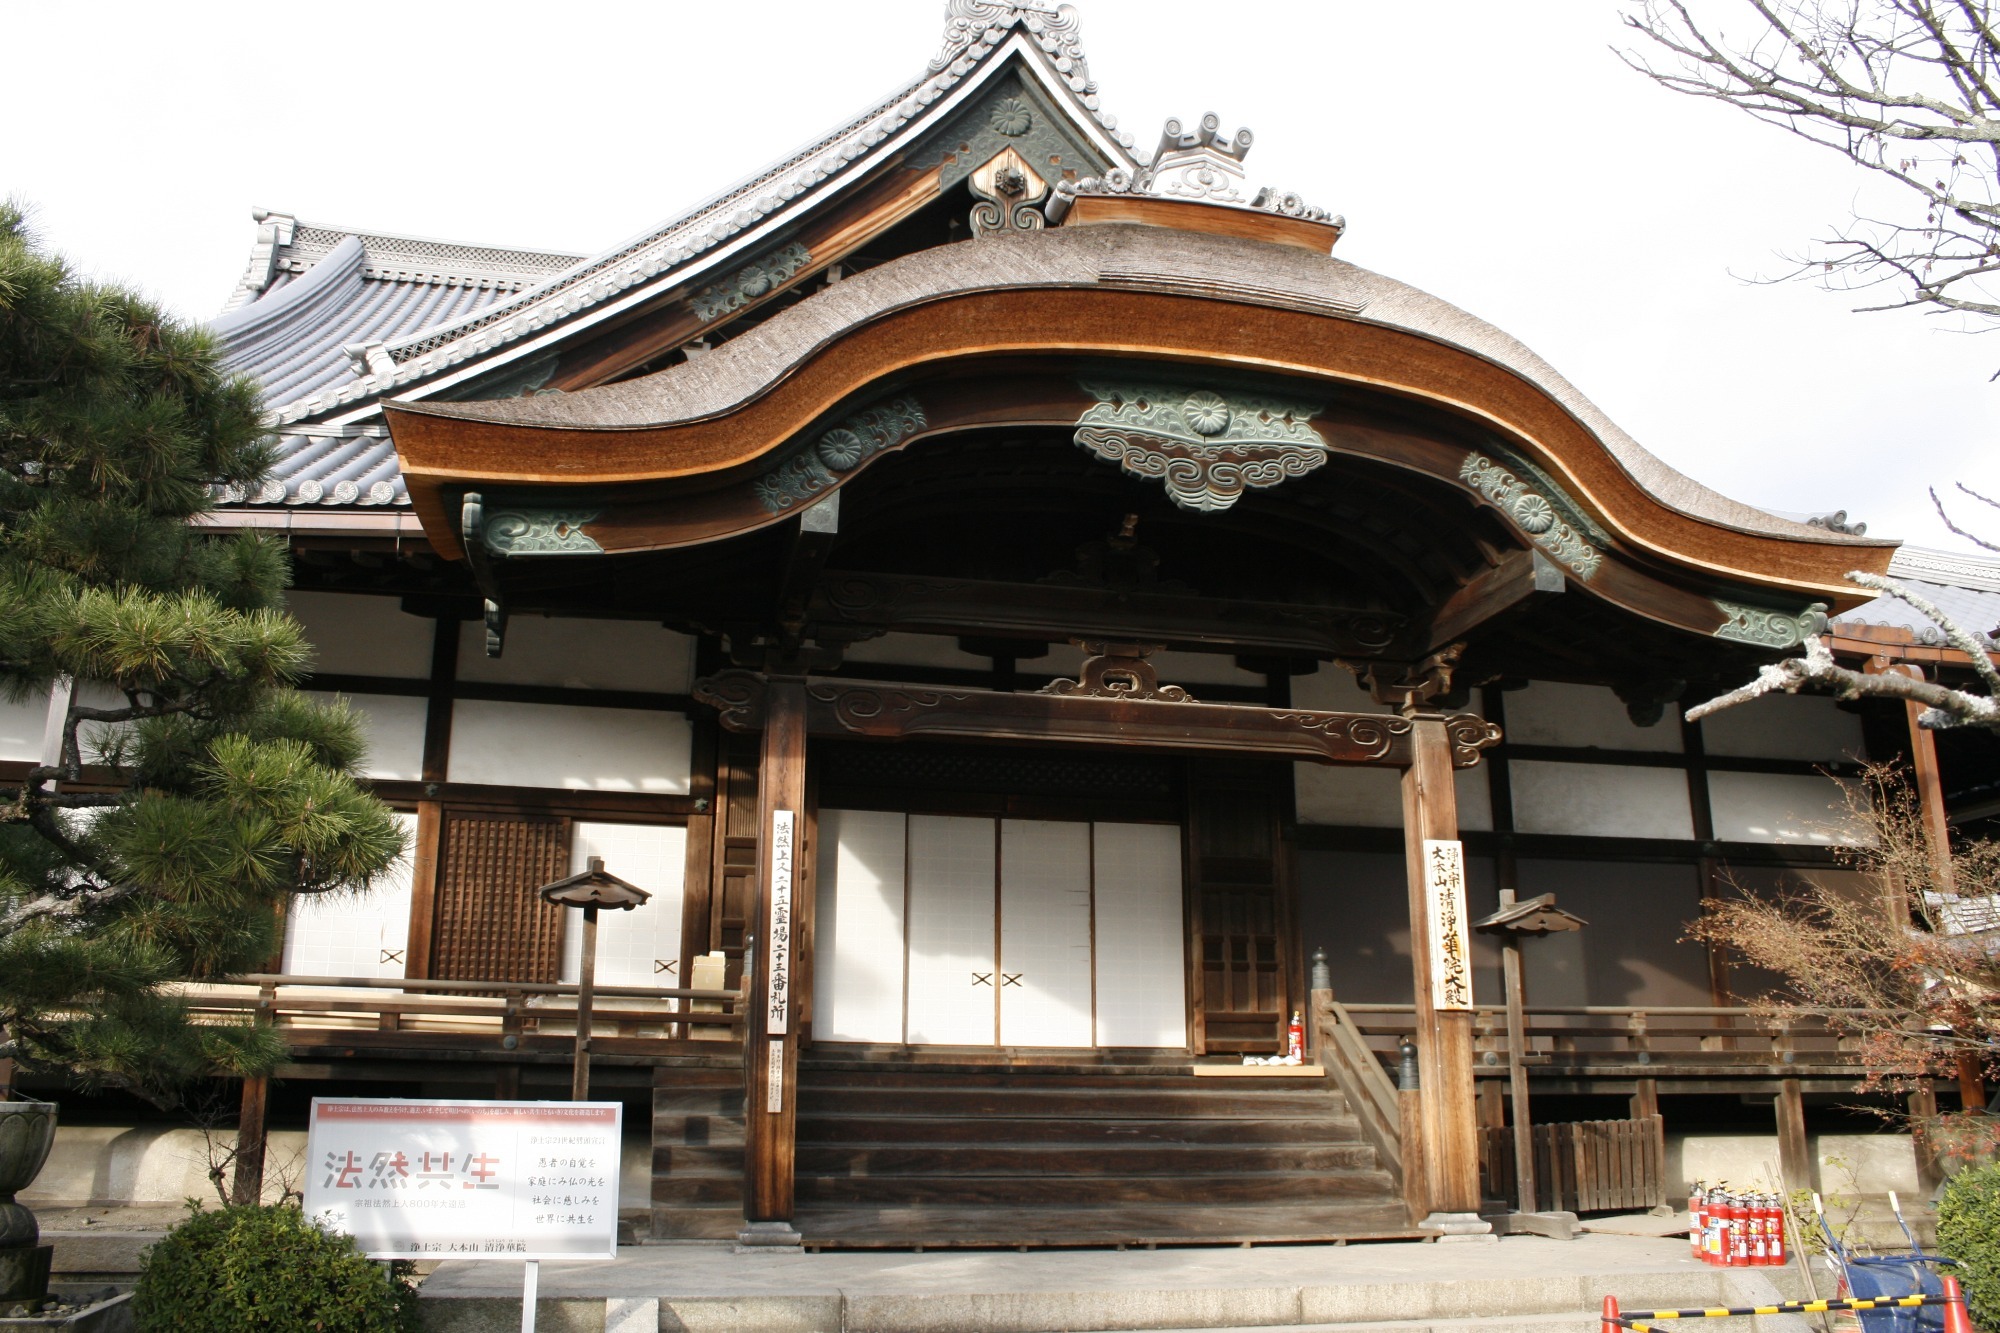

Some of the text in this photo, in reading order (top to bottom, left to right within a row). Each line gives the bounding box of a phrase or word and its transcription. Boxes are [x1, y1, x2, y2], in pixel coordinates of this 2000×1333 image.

[1432, 845, 1448, 887] 大本山
[1446, 847, 1460, 888] 浄土宗
[538, 1157, 596, 1168] 愚者の自覚を
[323, 1150, 500, 1190] 法然共生
[527, 1176, 605, 1187] 家庭にみ仏の光を
[532, 1195, 600, 1206] 社会に慈しみを
[536, 1213, 595, 1224] 世界に共生を
[410, 1242, 527, 1252] 浄土宗 大本山 清浄華院
